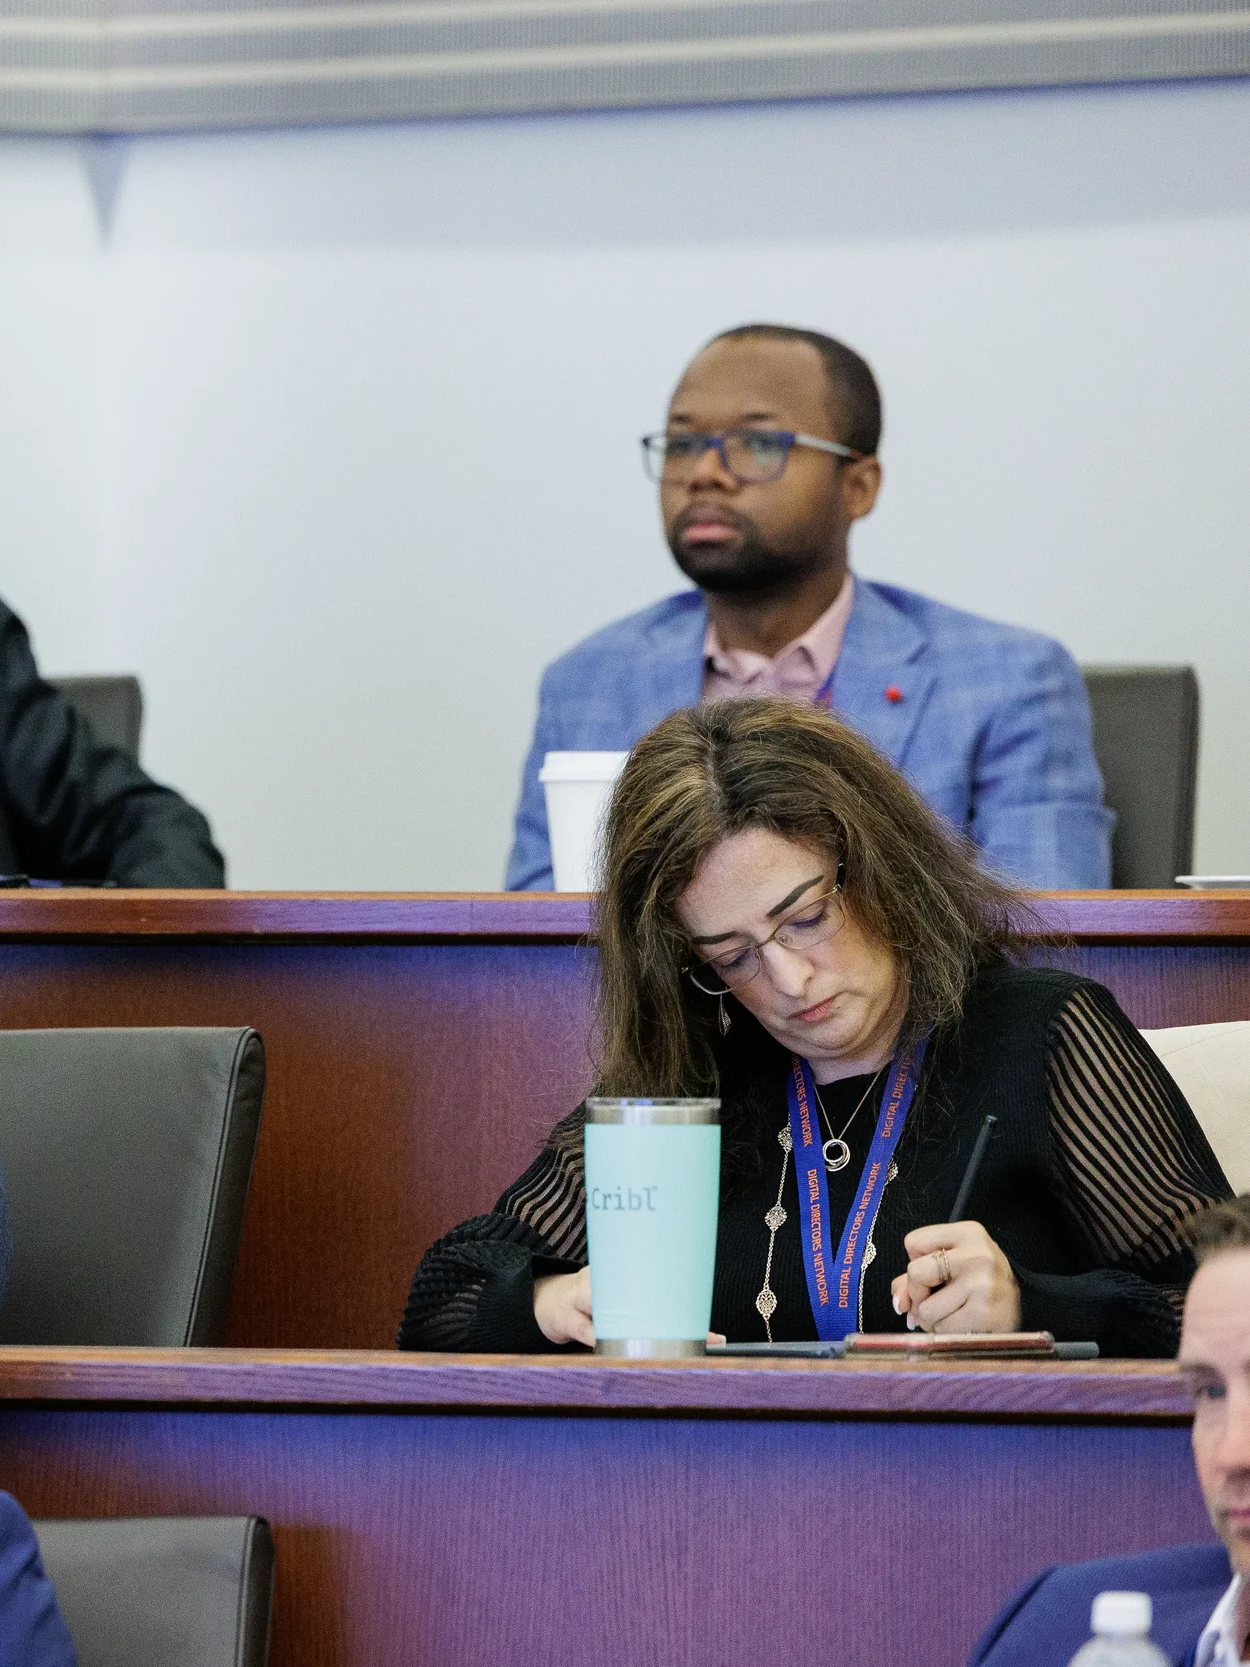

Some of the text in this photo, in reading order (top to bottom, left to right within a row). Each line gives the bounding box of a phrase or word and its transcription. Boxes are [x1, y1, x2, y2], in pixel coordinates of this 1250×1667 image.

[798, 1101, 813, 1147] NETWORK
[881, 1055, 912, 1138] DIGITAL DIRECT
[591, 1185, 656, 1212] Cribl
[807, 1168, 829, 1306] DIGITAL DIRECTORS NETWORK
[838, 1162, 881, 1308] DIGITAL DIRECTORS NETWORK
